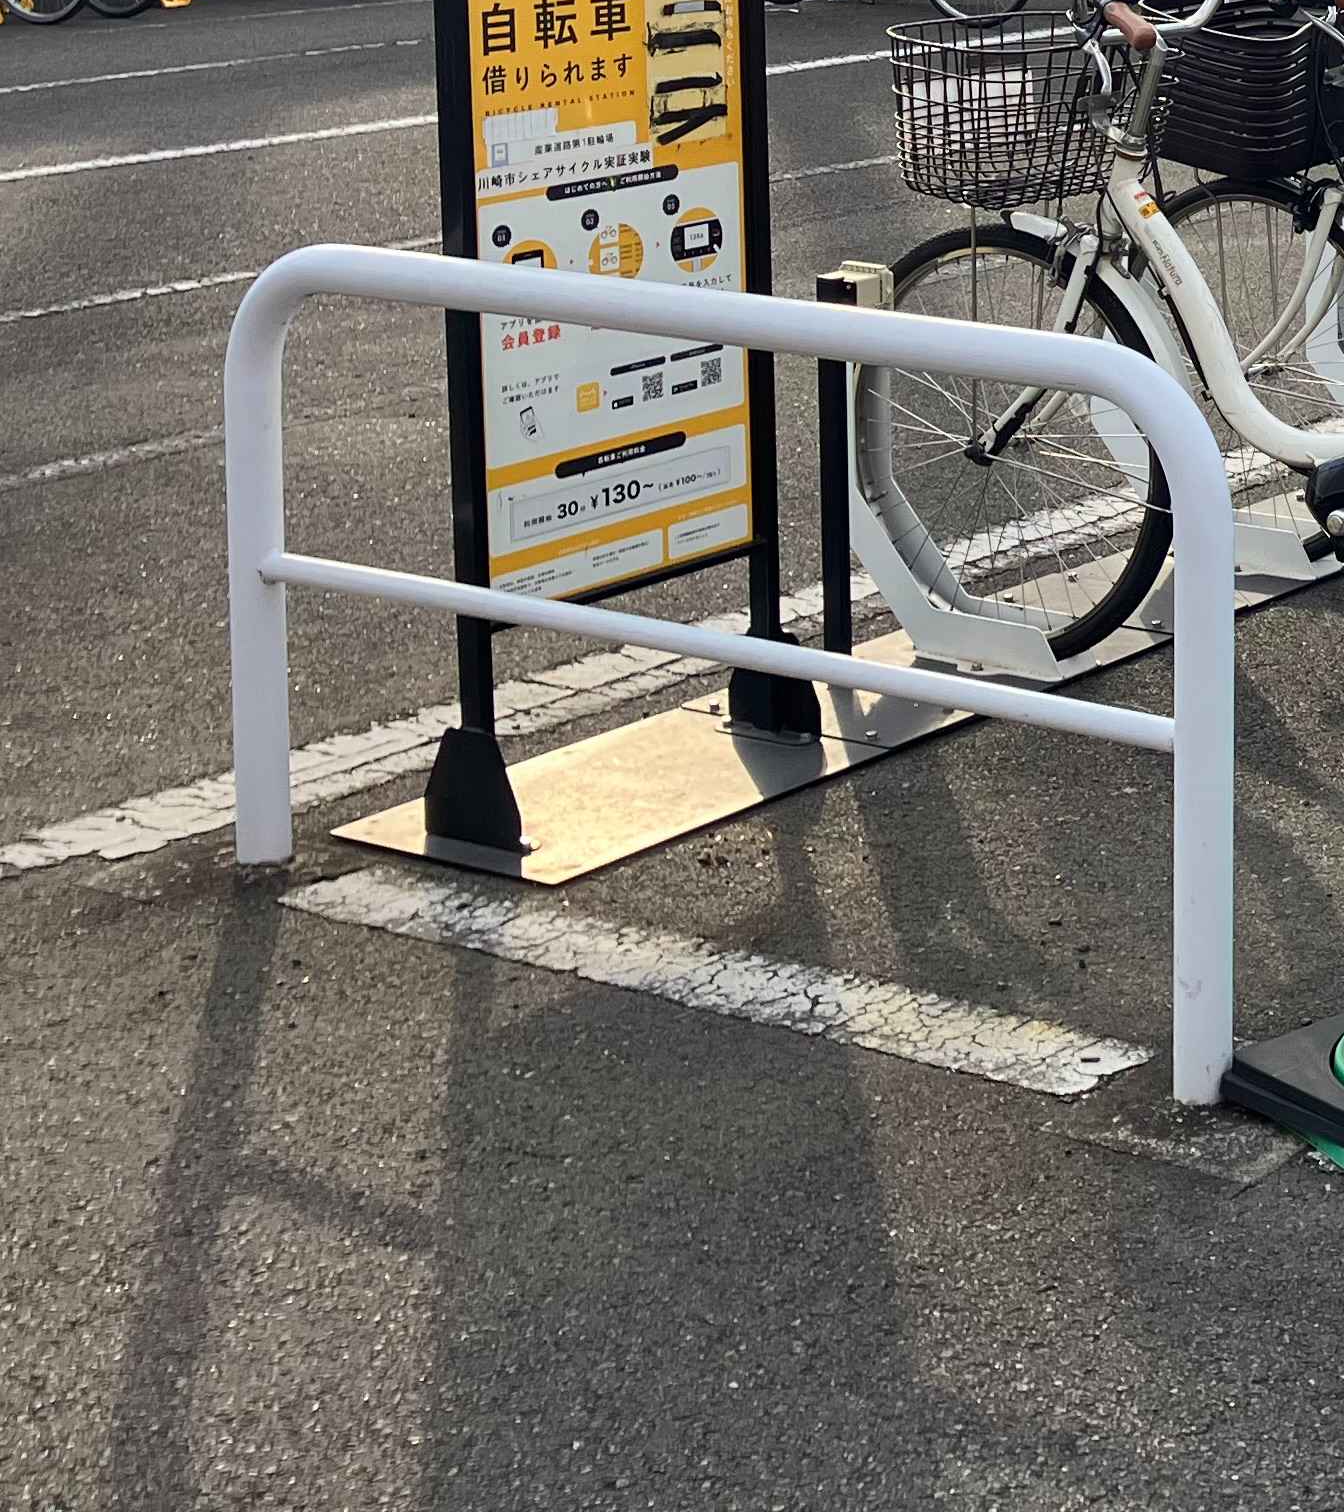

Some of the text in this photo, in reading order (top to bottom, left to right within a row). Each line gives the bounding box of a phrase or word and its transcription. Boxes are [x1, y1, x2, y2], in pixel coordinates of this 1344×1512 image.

[482, 53, 633, 96] 借りられます
[477, 148, 651, 192] 川崎市シェアサイクル実証実験
[502, 324, 561, 352] 会員登録
